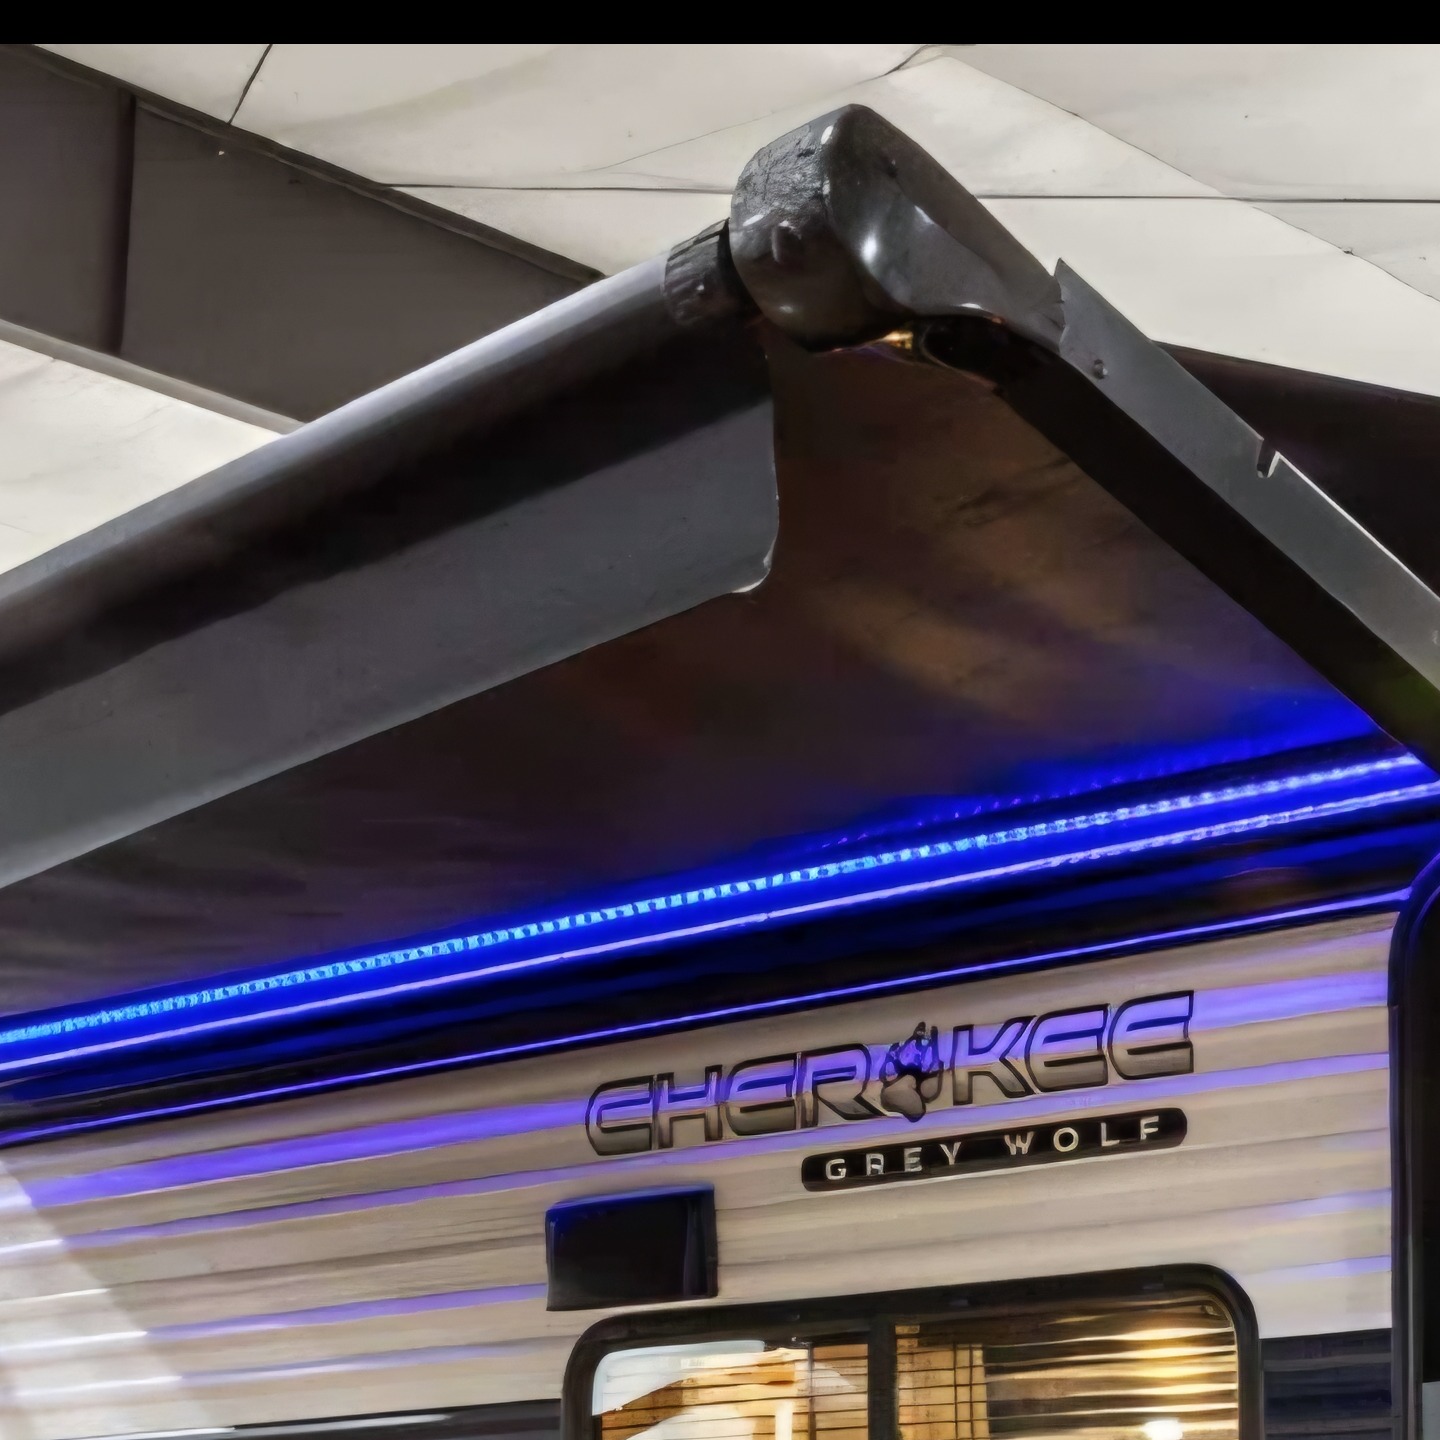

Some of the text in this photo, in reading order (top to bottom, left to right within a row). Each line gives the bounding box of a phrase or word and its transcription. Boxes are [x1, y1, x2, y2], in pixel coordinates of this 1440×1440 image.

[585, 990, 1195, 1156] CHEROKEE
[824, 1115, 1160, 1181] GREY WOLF
